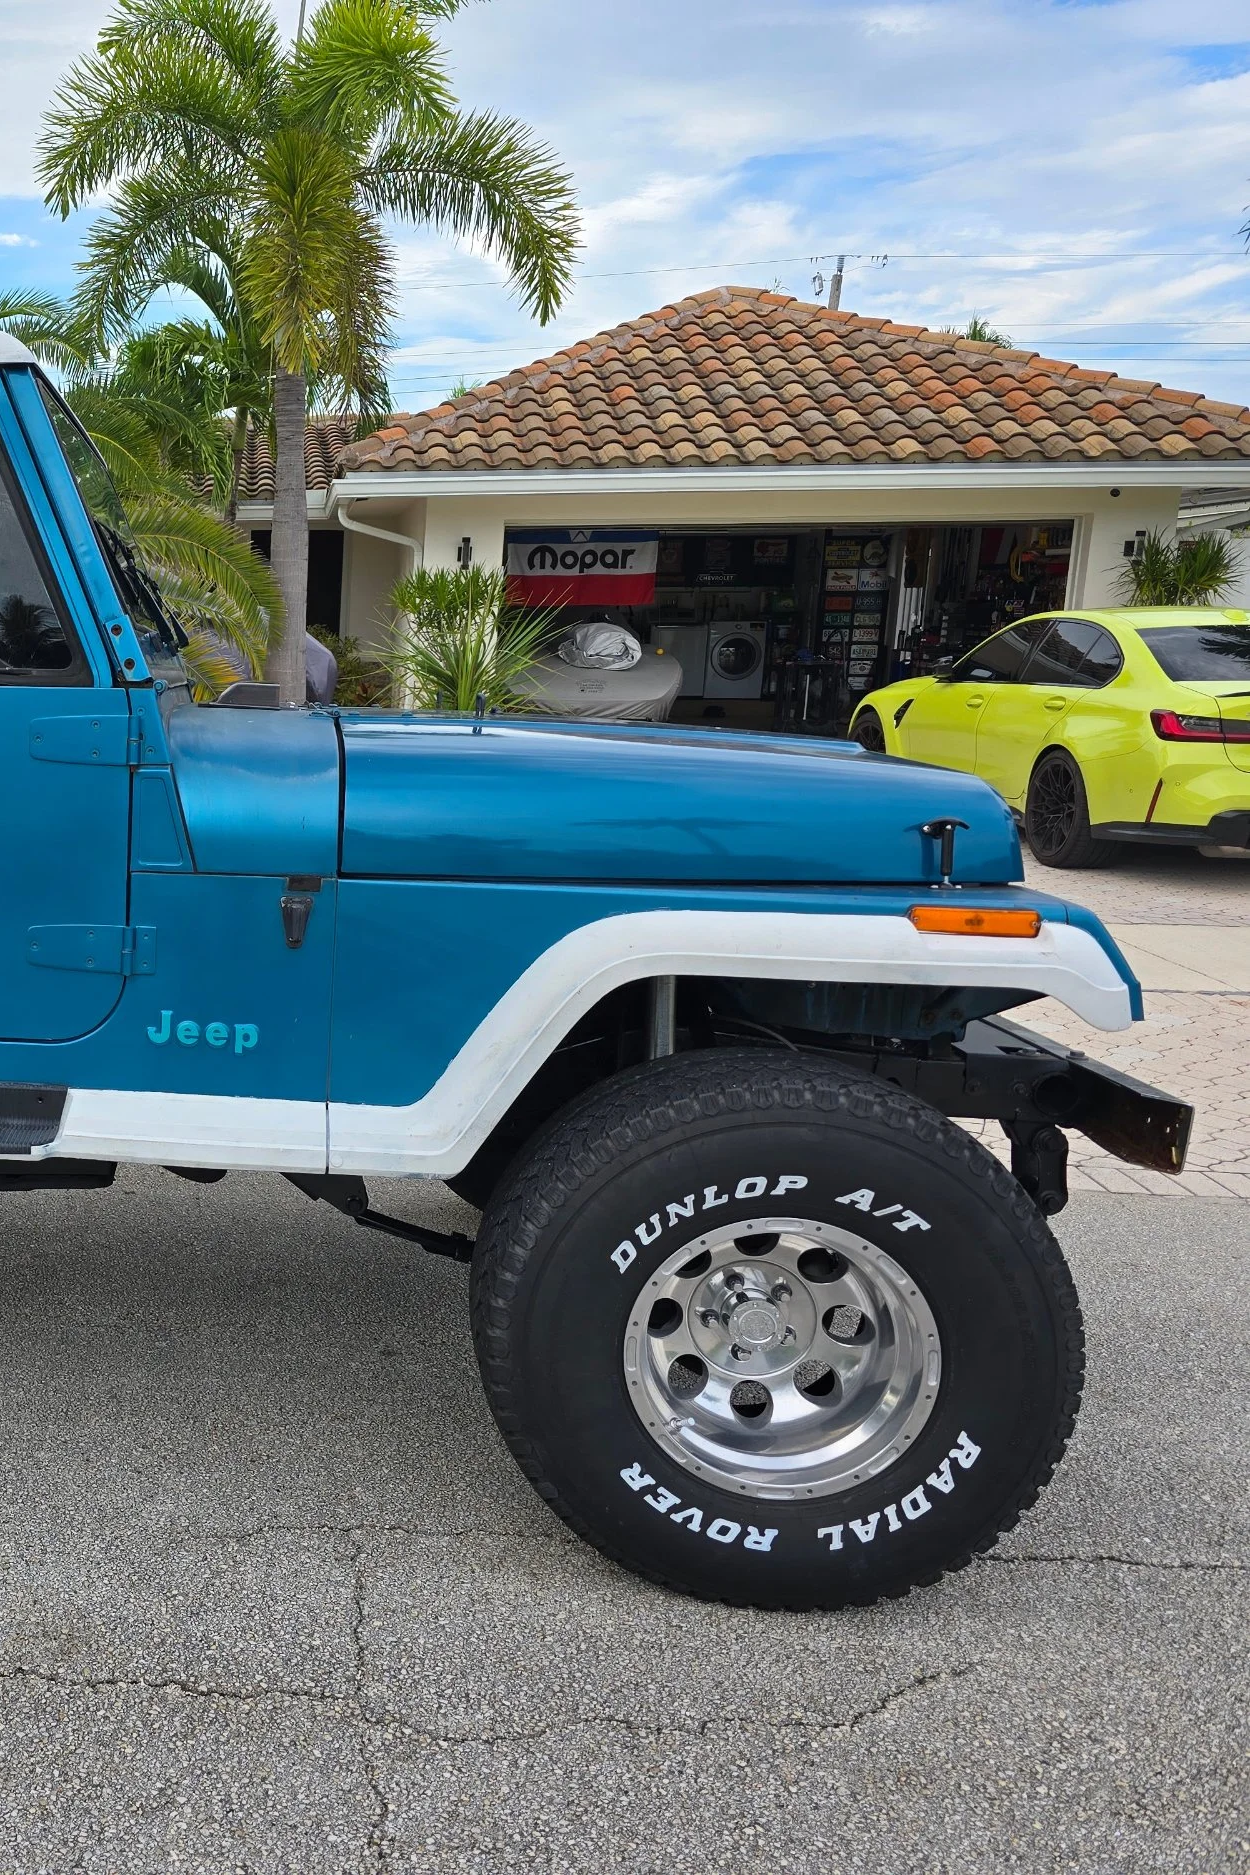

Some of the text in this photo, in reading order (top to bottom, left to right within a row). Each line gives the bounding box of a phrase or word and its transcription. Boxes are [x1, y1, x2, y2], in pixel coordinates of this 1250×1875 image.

[527, 545, 637, 573] Mopar
[861, 580, 887, 588] Mobil
[146, 1009, 261, 1054] Jeep
[610, 1175, 932, 1275] DUNLOP A/T
[619, 1430, 982, 1552] RADIAL ROVER
